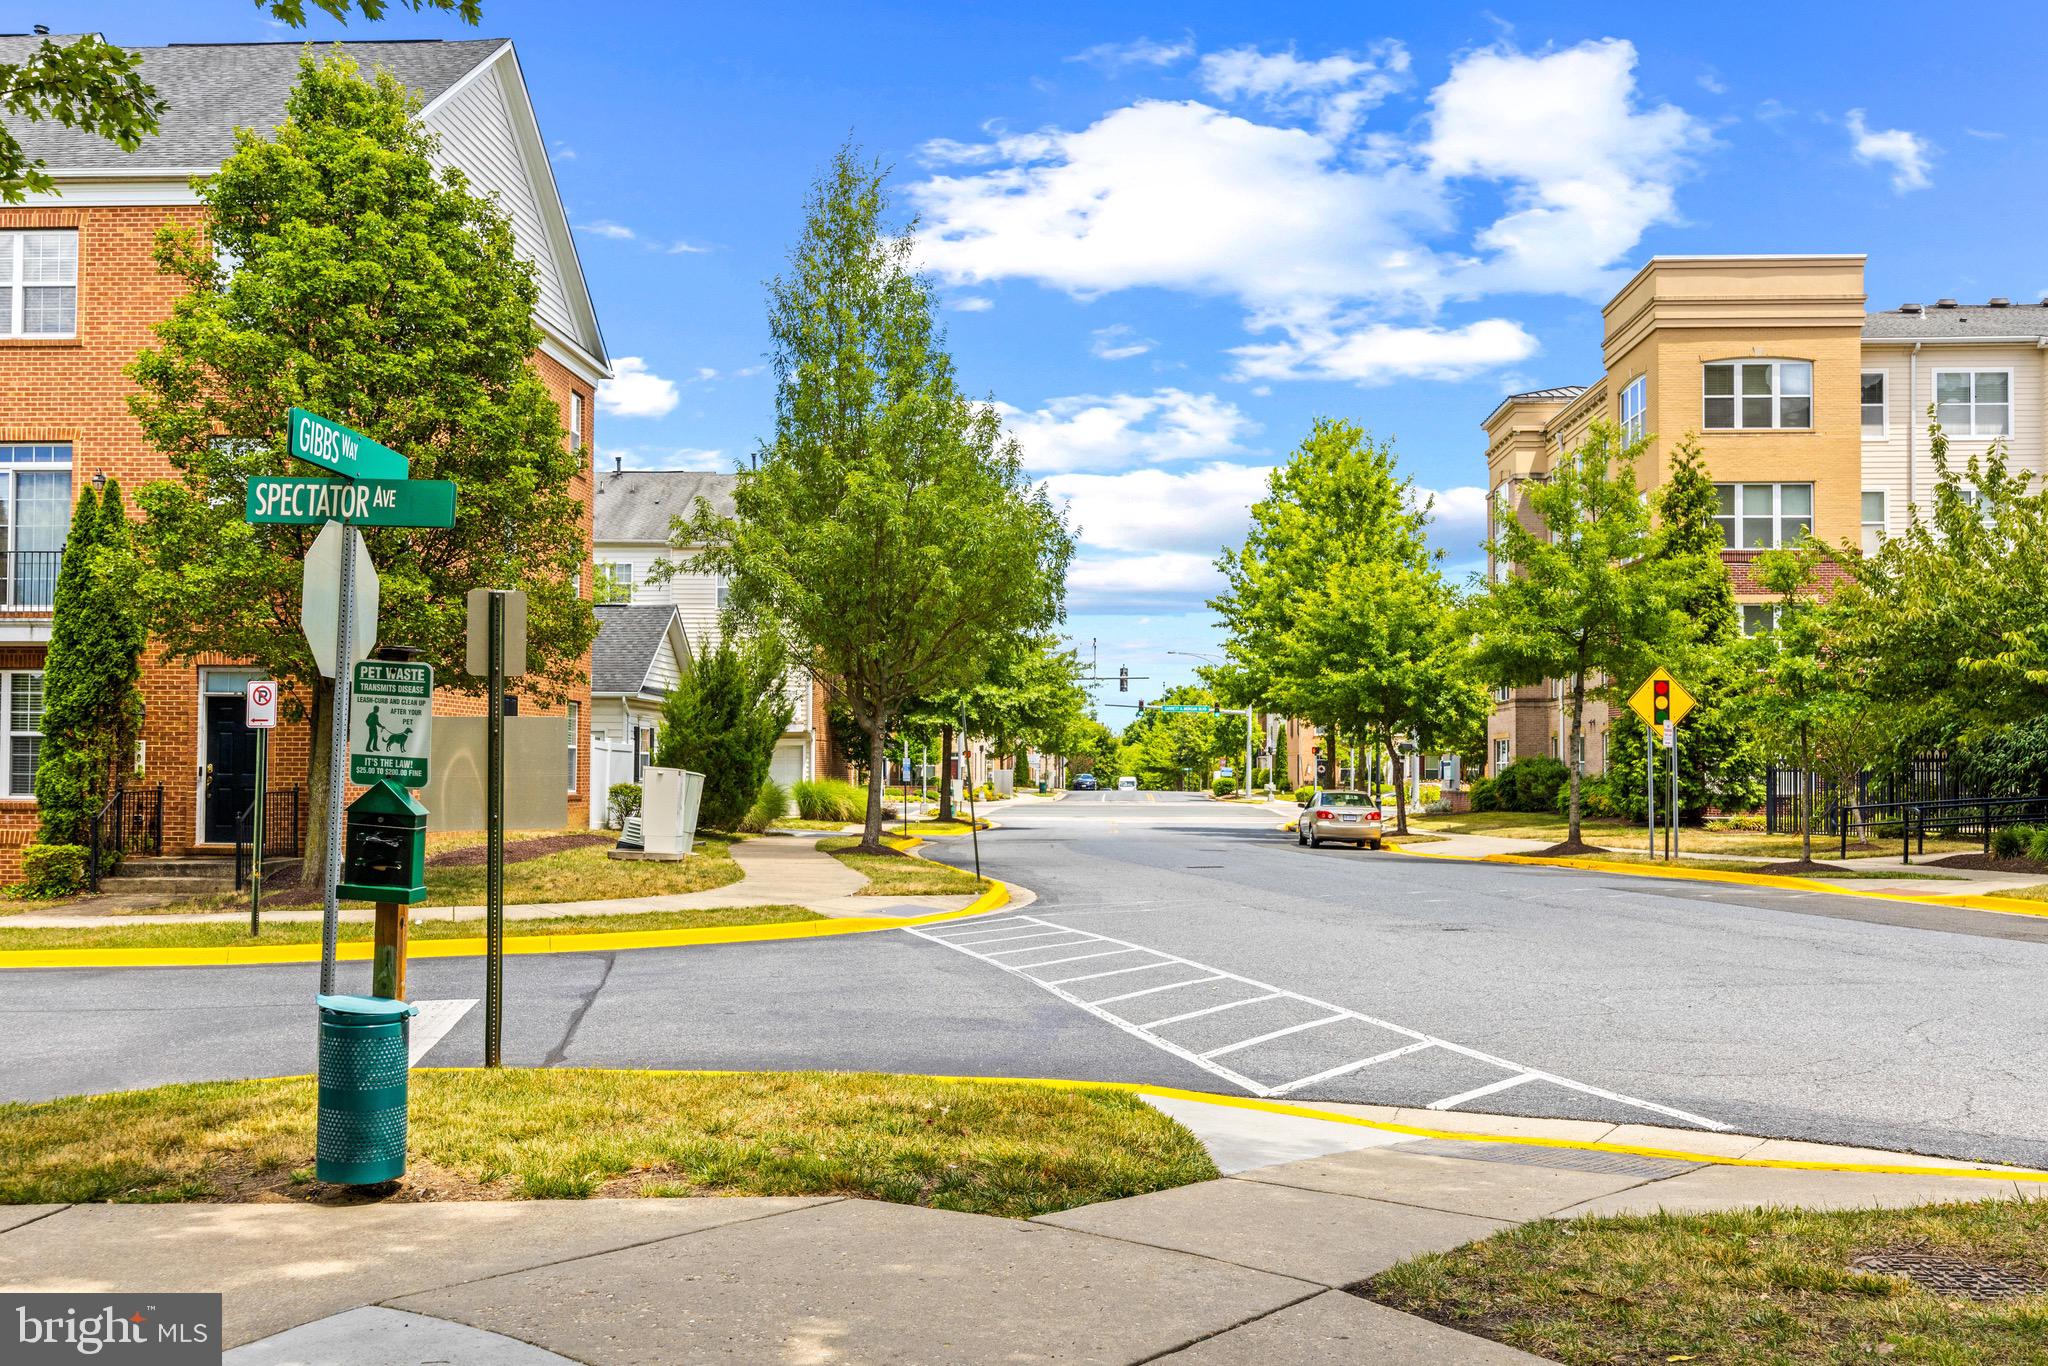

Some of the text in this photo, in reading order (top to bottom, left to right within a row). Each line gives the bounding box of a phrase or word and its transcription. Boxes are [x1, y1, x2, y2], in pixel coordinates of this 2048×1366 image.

[299, 417, 340, 464] GIBBS
[255, 482, 397, 518] SPECTATOR AVE
[360, 666, 425, 681] PET WASTE
[360, 683, 424, 694] TRANSMITS DISEASE
[357, 696, 389, 704] LEASH-CURB
[364, 758, 414, 768] IT'S THE LAW!
[356, 766, 375, 774] $25.00
[408, 769, 422, 777] FINE
